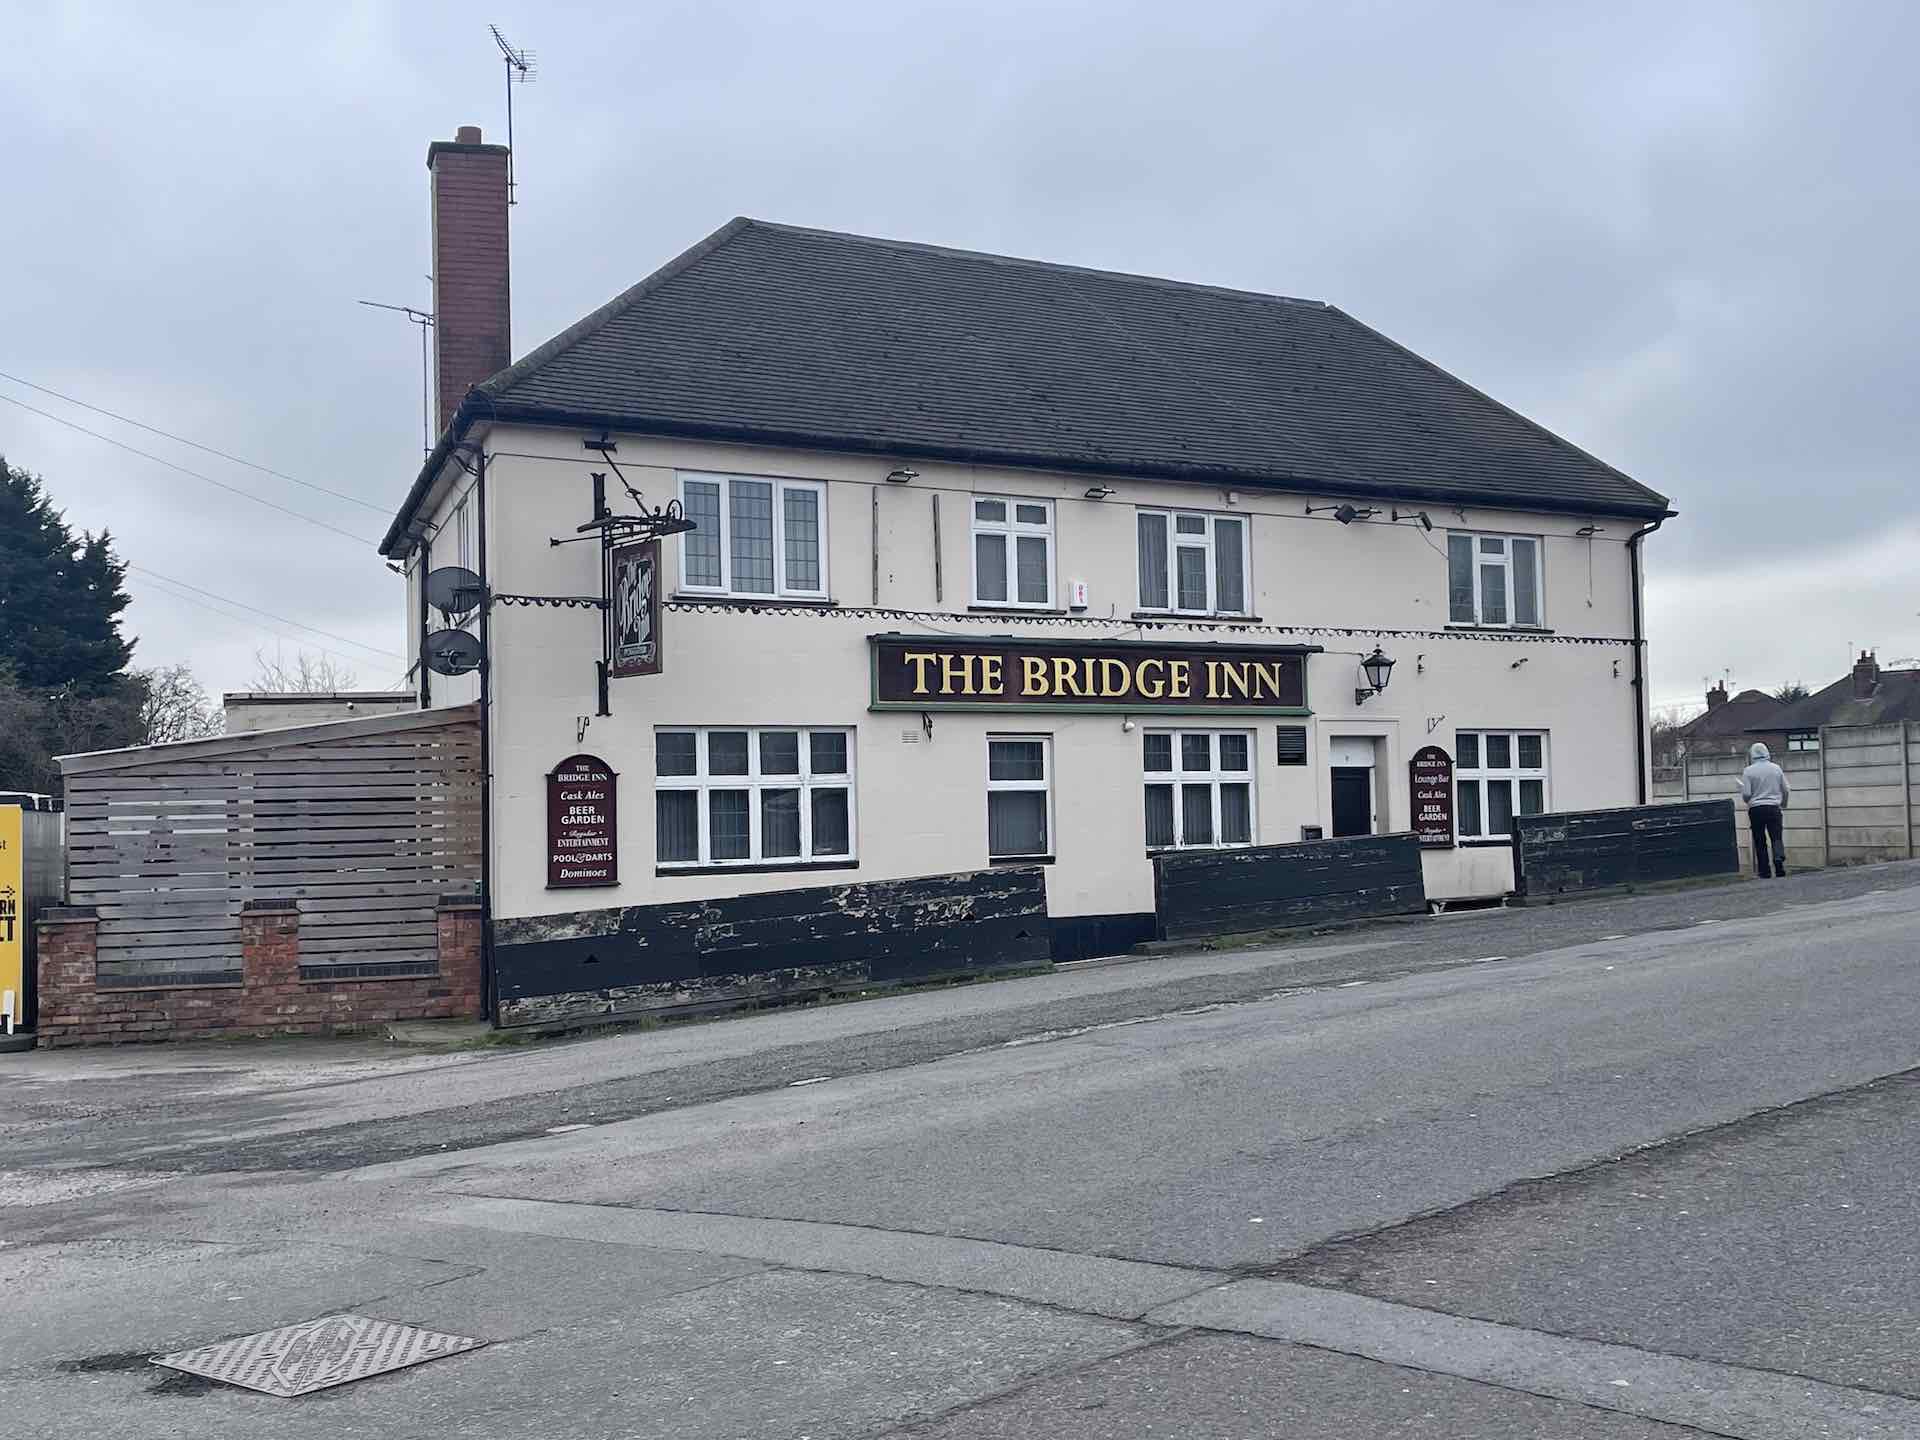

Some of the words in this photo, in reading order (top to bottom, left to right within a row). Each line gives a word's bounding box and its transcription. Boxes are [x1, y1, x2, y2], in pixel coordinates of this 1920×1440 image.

[904, 651, 1004, 696] THE
[1020, 655, 1191, 699] BRIDGE
[1205, 660, 1282, 699] INN
[557, 773, 591, 782] BRIDGE
[591, 773, 607, 781] INN
[1414, 774, 1438, 785] Lounge
[1438, 775, 1449, 783] Bar
[560, 791, 584, 800] Cask
[584, 791, 605, 800] Ales
[569, 806, 595, 815] BEER
[561, 815, 605, 824] GARDEN
[1418, 813, 1447, 821] GARDEN
[557, 838, 609, 848] ENTERTAINMENT
[560, 868, 607, 879] Dominoes
